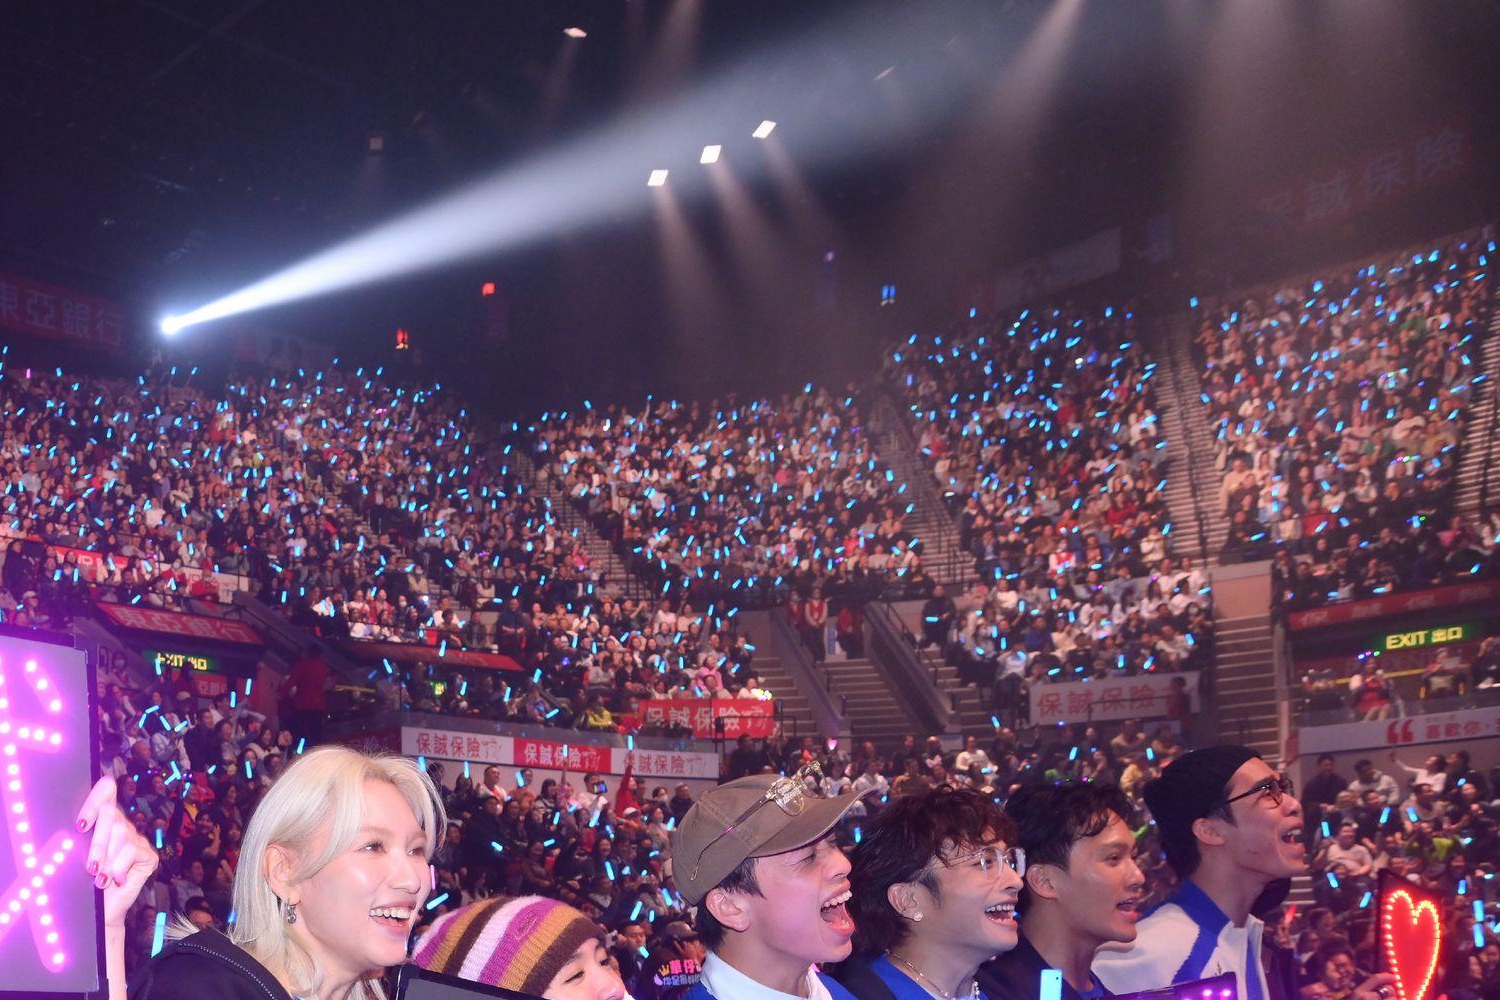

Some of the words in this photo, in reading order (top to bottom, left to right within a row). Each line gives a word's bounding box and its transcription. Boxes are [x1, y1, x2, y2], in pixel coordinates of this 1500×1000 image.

[109, 607, 253, 644] 東亞銀行
[1385, 630, 1429, 651] EXIT
[1430, 625, 1464, 644] 出口
[1036, 684, 1157, 718] 保誠保險
[647, 705, 741, 732] 保誠保險
[416, 732, 481, 758] 保誠保險
[524, 744, 582, 769] 保誠保險
[623, 750, 686, 775] 保誠保險
